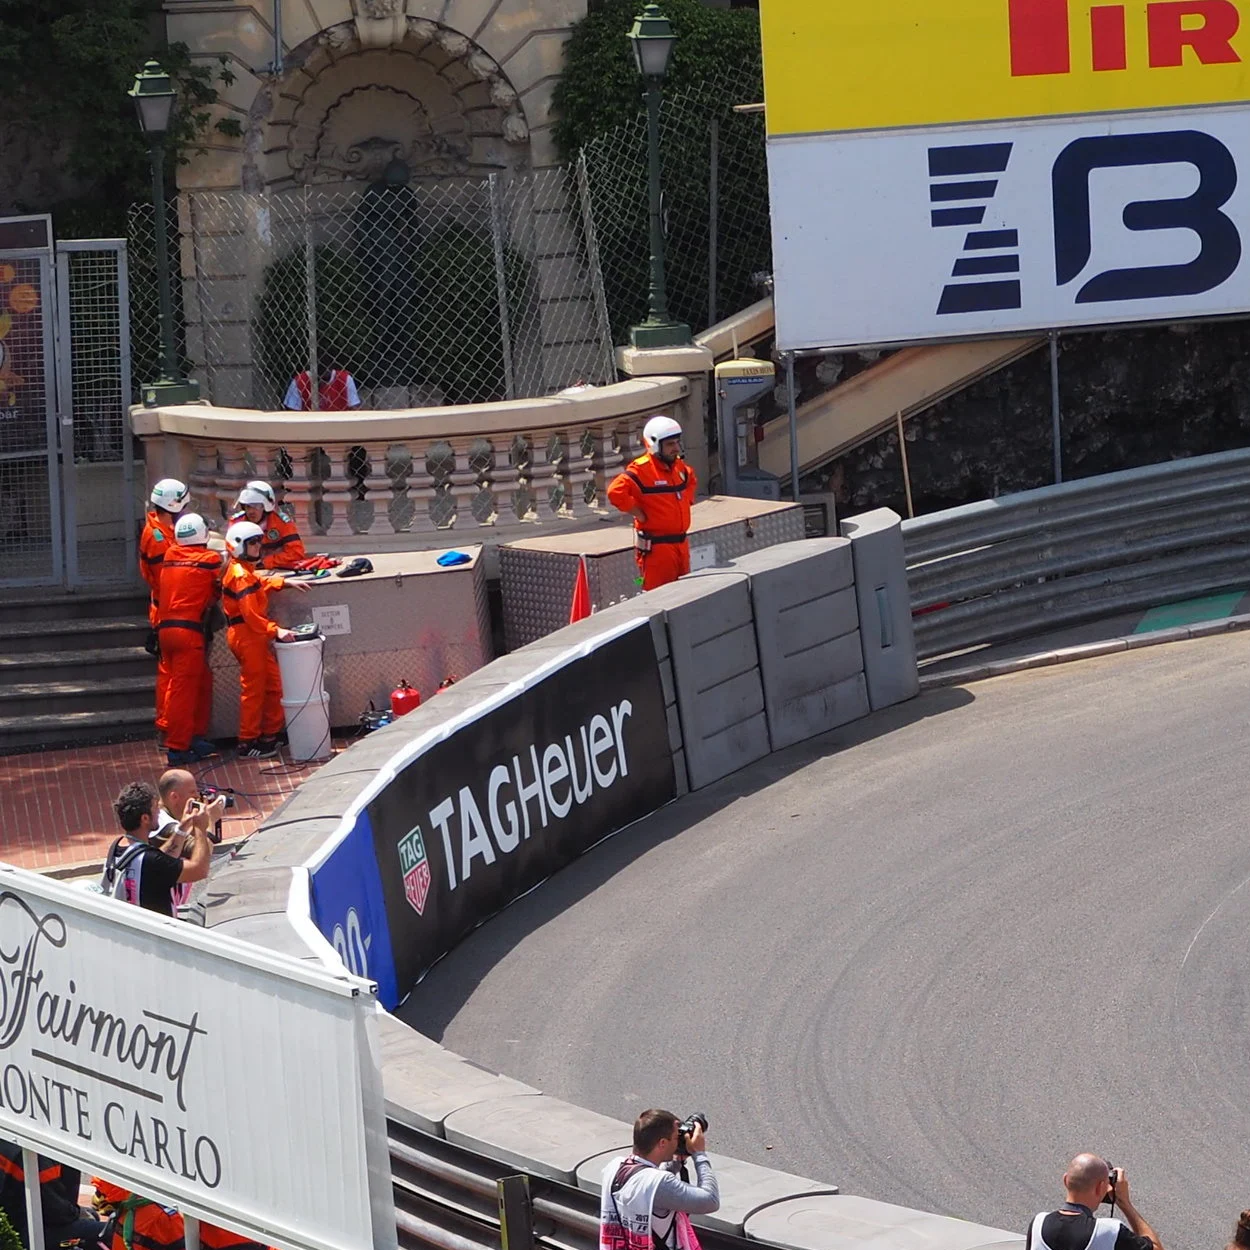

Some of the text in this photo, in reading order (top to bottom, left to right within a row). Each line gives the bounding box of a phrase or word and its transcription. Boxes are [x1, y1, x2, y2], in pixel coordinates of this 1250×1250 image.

[401, 833, 424, 870] TAG
[406, 866, 430, 908] HEUER
[0, 1064, 222, 1189] ONTE CARLO
